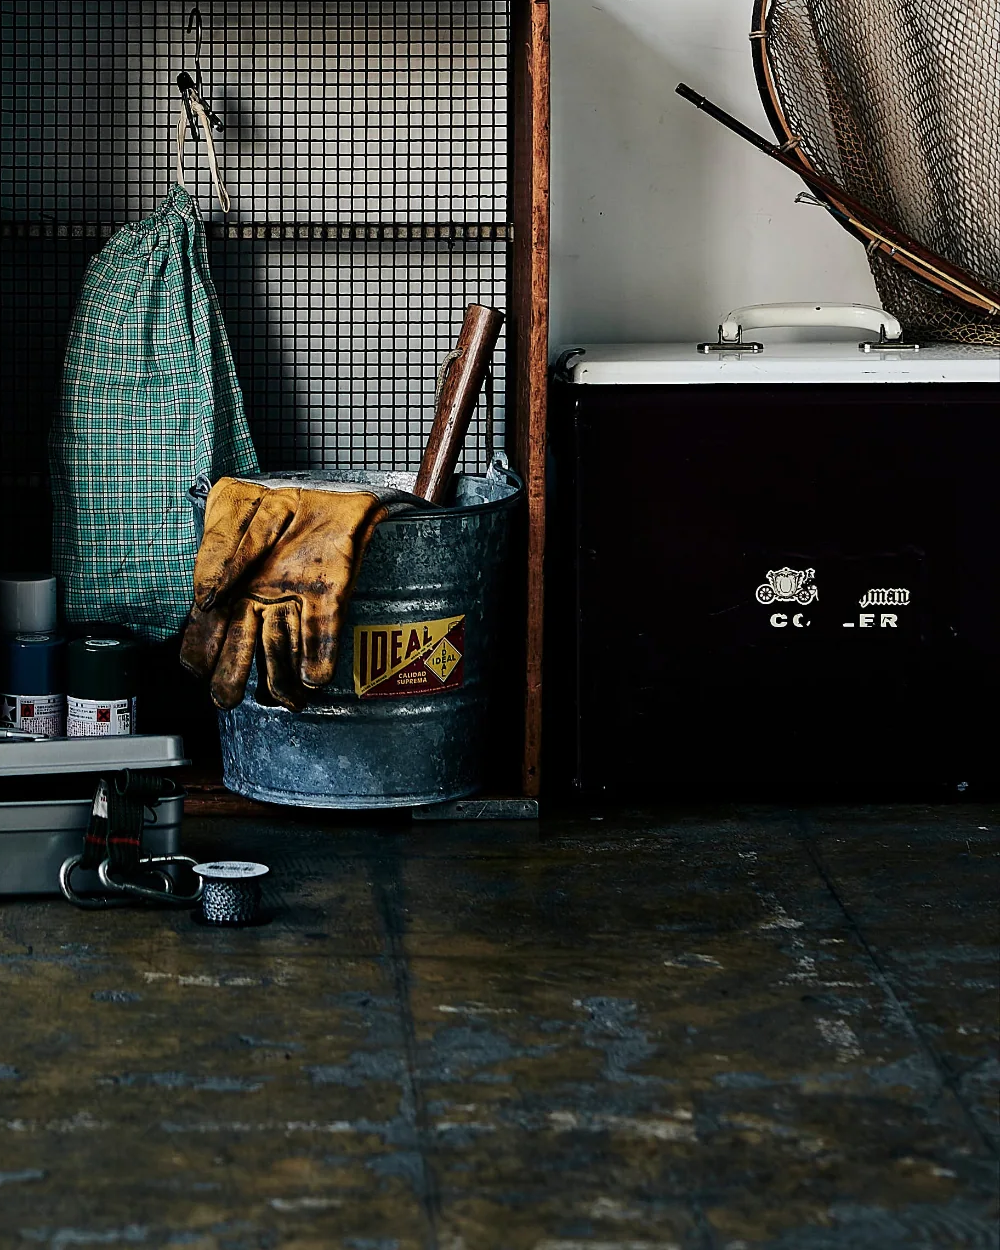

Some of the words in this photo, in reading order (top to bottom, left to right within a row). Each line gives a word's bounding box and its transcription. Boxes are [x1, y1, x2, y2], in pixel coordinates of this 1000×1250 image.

[360, 626, 433, 688] IDEAL
[432, 654, 456, 665] IDEAL
[398, 671, 427, 679] CALIDAD
[397, 678, 428, 686] SUPREMA
